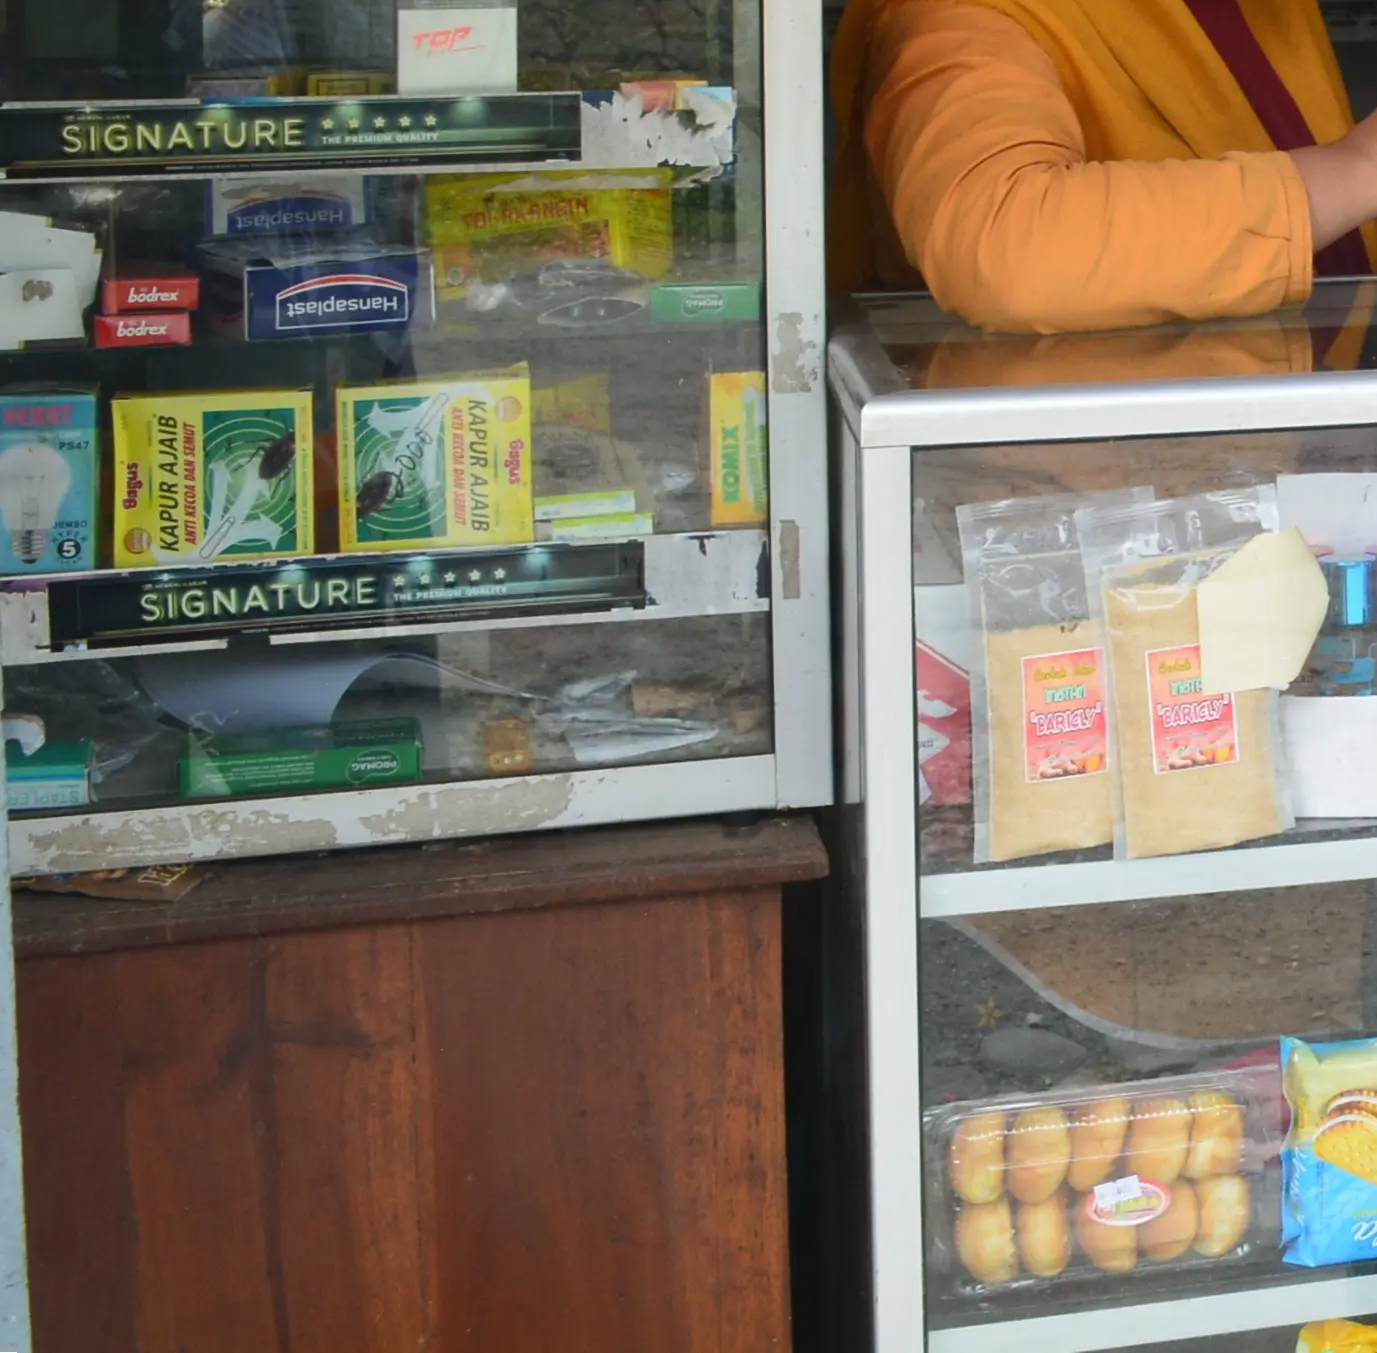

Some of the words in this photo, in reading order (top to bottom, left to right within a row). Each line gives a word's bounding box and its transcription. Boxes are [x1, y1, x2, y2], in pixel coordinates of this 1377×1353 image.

[411, 25, 472, 50] TOP
[62, 118, 306, 155] SIGNATURE
[321, 134, 343, 145] THE
[344, 132, 393, 145] PREMIUM
[394, 130, 441, 143] QUALITY
[235, 208, 344, 231] Hansaplast
[127, 286, 180, 305] bodrex
[286, 294, 399, 319] Hansaplast
[116, 320, 169, 338] bodrex
[451, 407, 465, 431] ANTI
[158, 415, 179, 477] AJAIB
[184, 421, 197, 459] SEMUT
[468, 399, 488, 469] KAPUR
[451, 435, 465, 465] KECOA
[504, 438, 525, 486] Bagus
[720, 424, 741, 503] KOMIX
[185, 458, 197, 482] DAN
[452, 467, 465, 488] DAN
[122, 461, 144, 511] Bagus
[183, 482, 198, 517] KECOA
[158, 480, 180, 552] KAPUR
[452, 490, 467, 526] SEMUT
[470, 473, 490, 532] AJAIB
[183, 517, 198, 545] ANTI
[60, 540, 76, 558] 5
[140, 576, 379, 622] SIGNATURE
[393, 592, 414, 602] THE
[415, 589, 463, 601] PREMIUM
[464, 585, 508, 597] QUALITY
[351, 759, 398, 772] PROMAG
